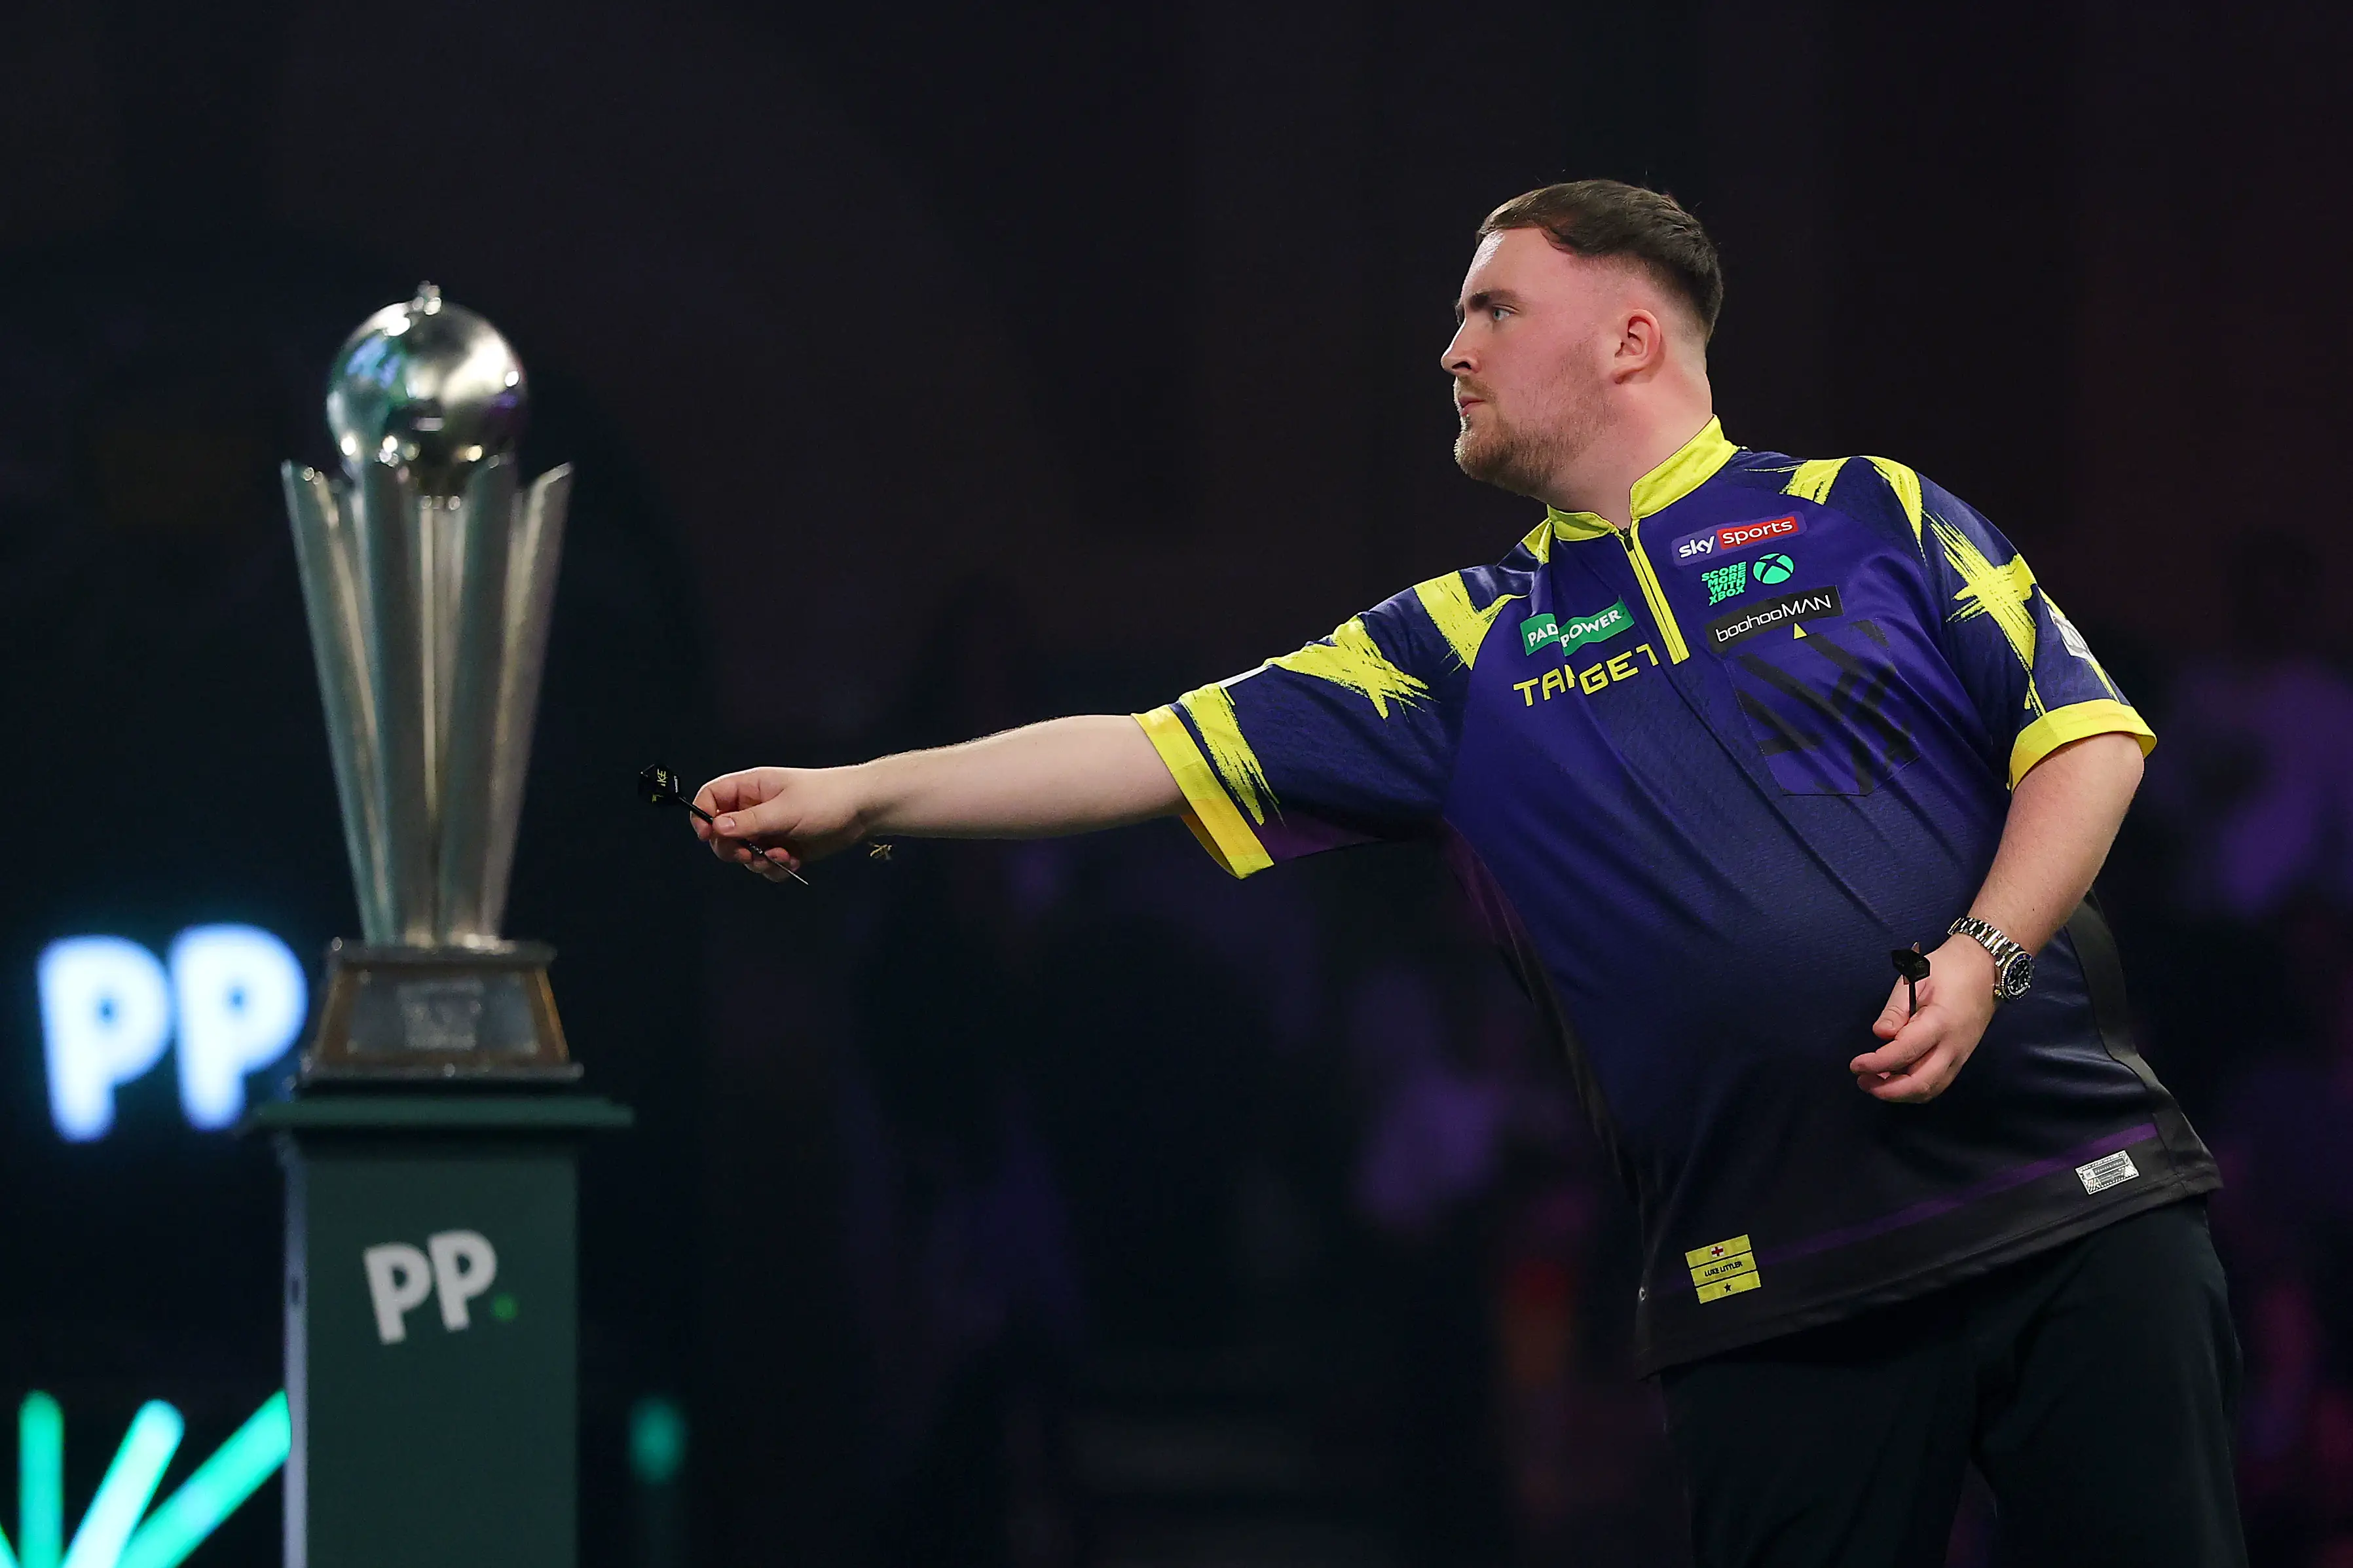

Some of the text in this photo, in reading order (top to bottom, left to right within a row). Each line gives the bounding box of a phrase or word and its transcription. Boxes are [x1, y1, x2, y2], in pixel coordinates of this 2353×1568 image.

[1678, 520, 1793, 558] sky sports
[1701, 561, 1747, 581] SCORE
[1707, 570, 1746, 588] MORE
[1708, 585, 1745, 606] XBOX
[1710, 577, 1745, 596] WITH
[1527, 609, 1622, 648] PAD POWER
[1715, 594, 1832, 642] boohooMAN
[36, 921, 310, 1143] PP
[1720, 1261, 1743, 1273] LITTLER
